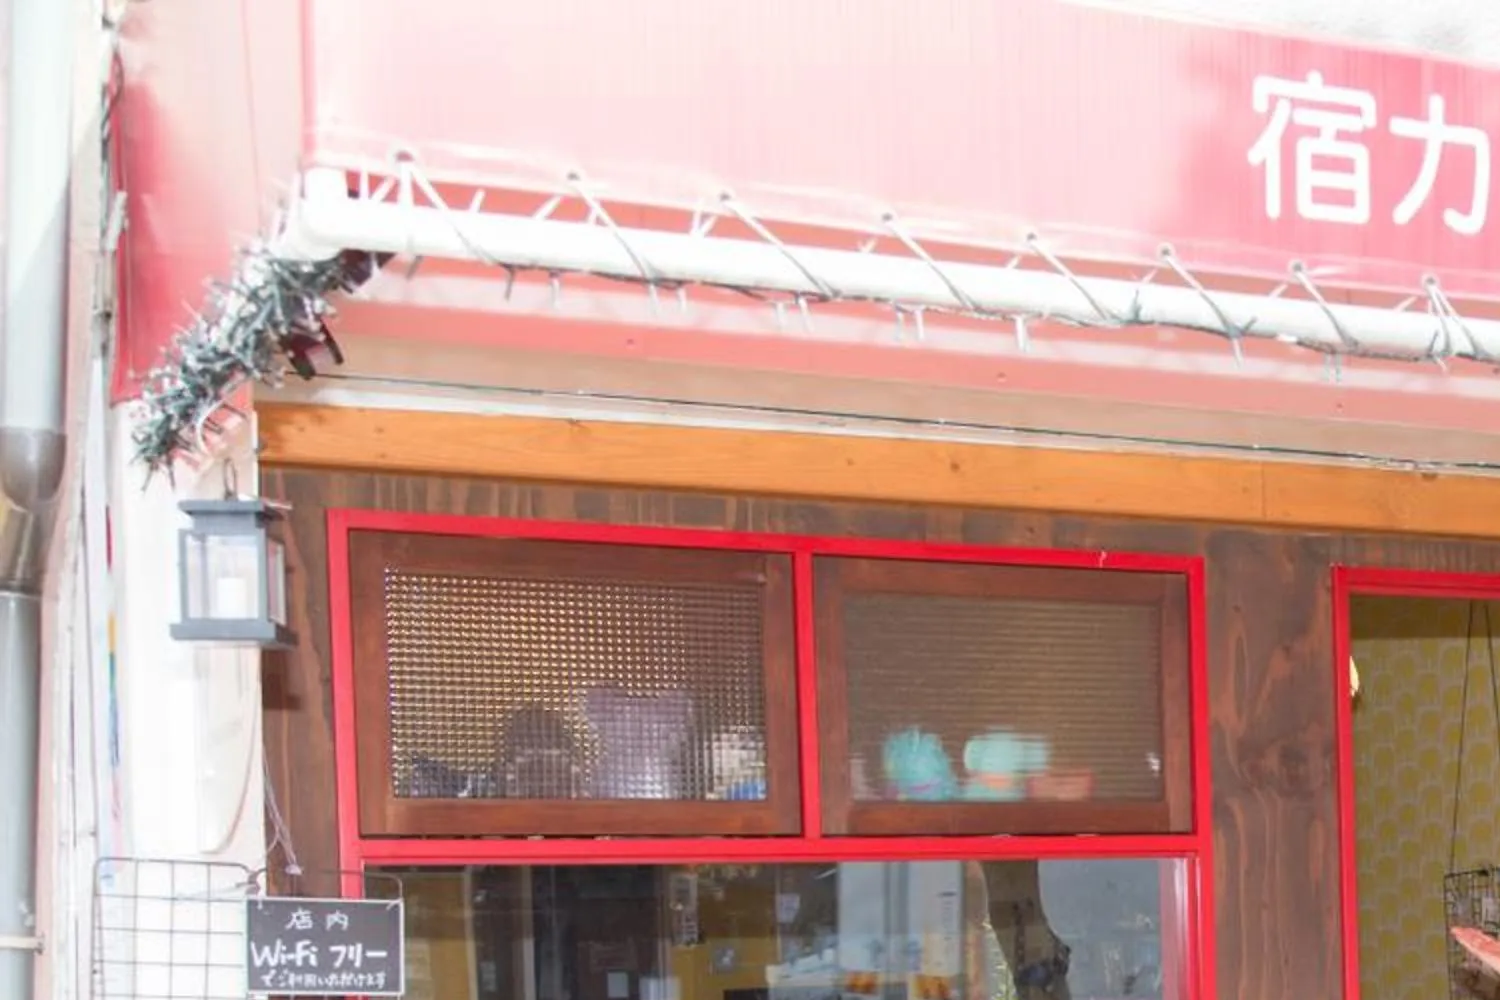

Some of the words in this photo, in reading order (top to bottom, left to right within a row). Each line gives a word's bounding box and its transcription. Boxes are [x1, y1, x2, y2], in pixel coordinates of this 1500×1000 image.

[285, 908, 350, 931] 店内
[250, 938, 318, 967] Wi-Fi
[328, 942, 388, 968] フリー
